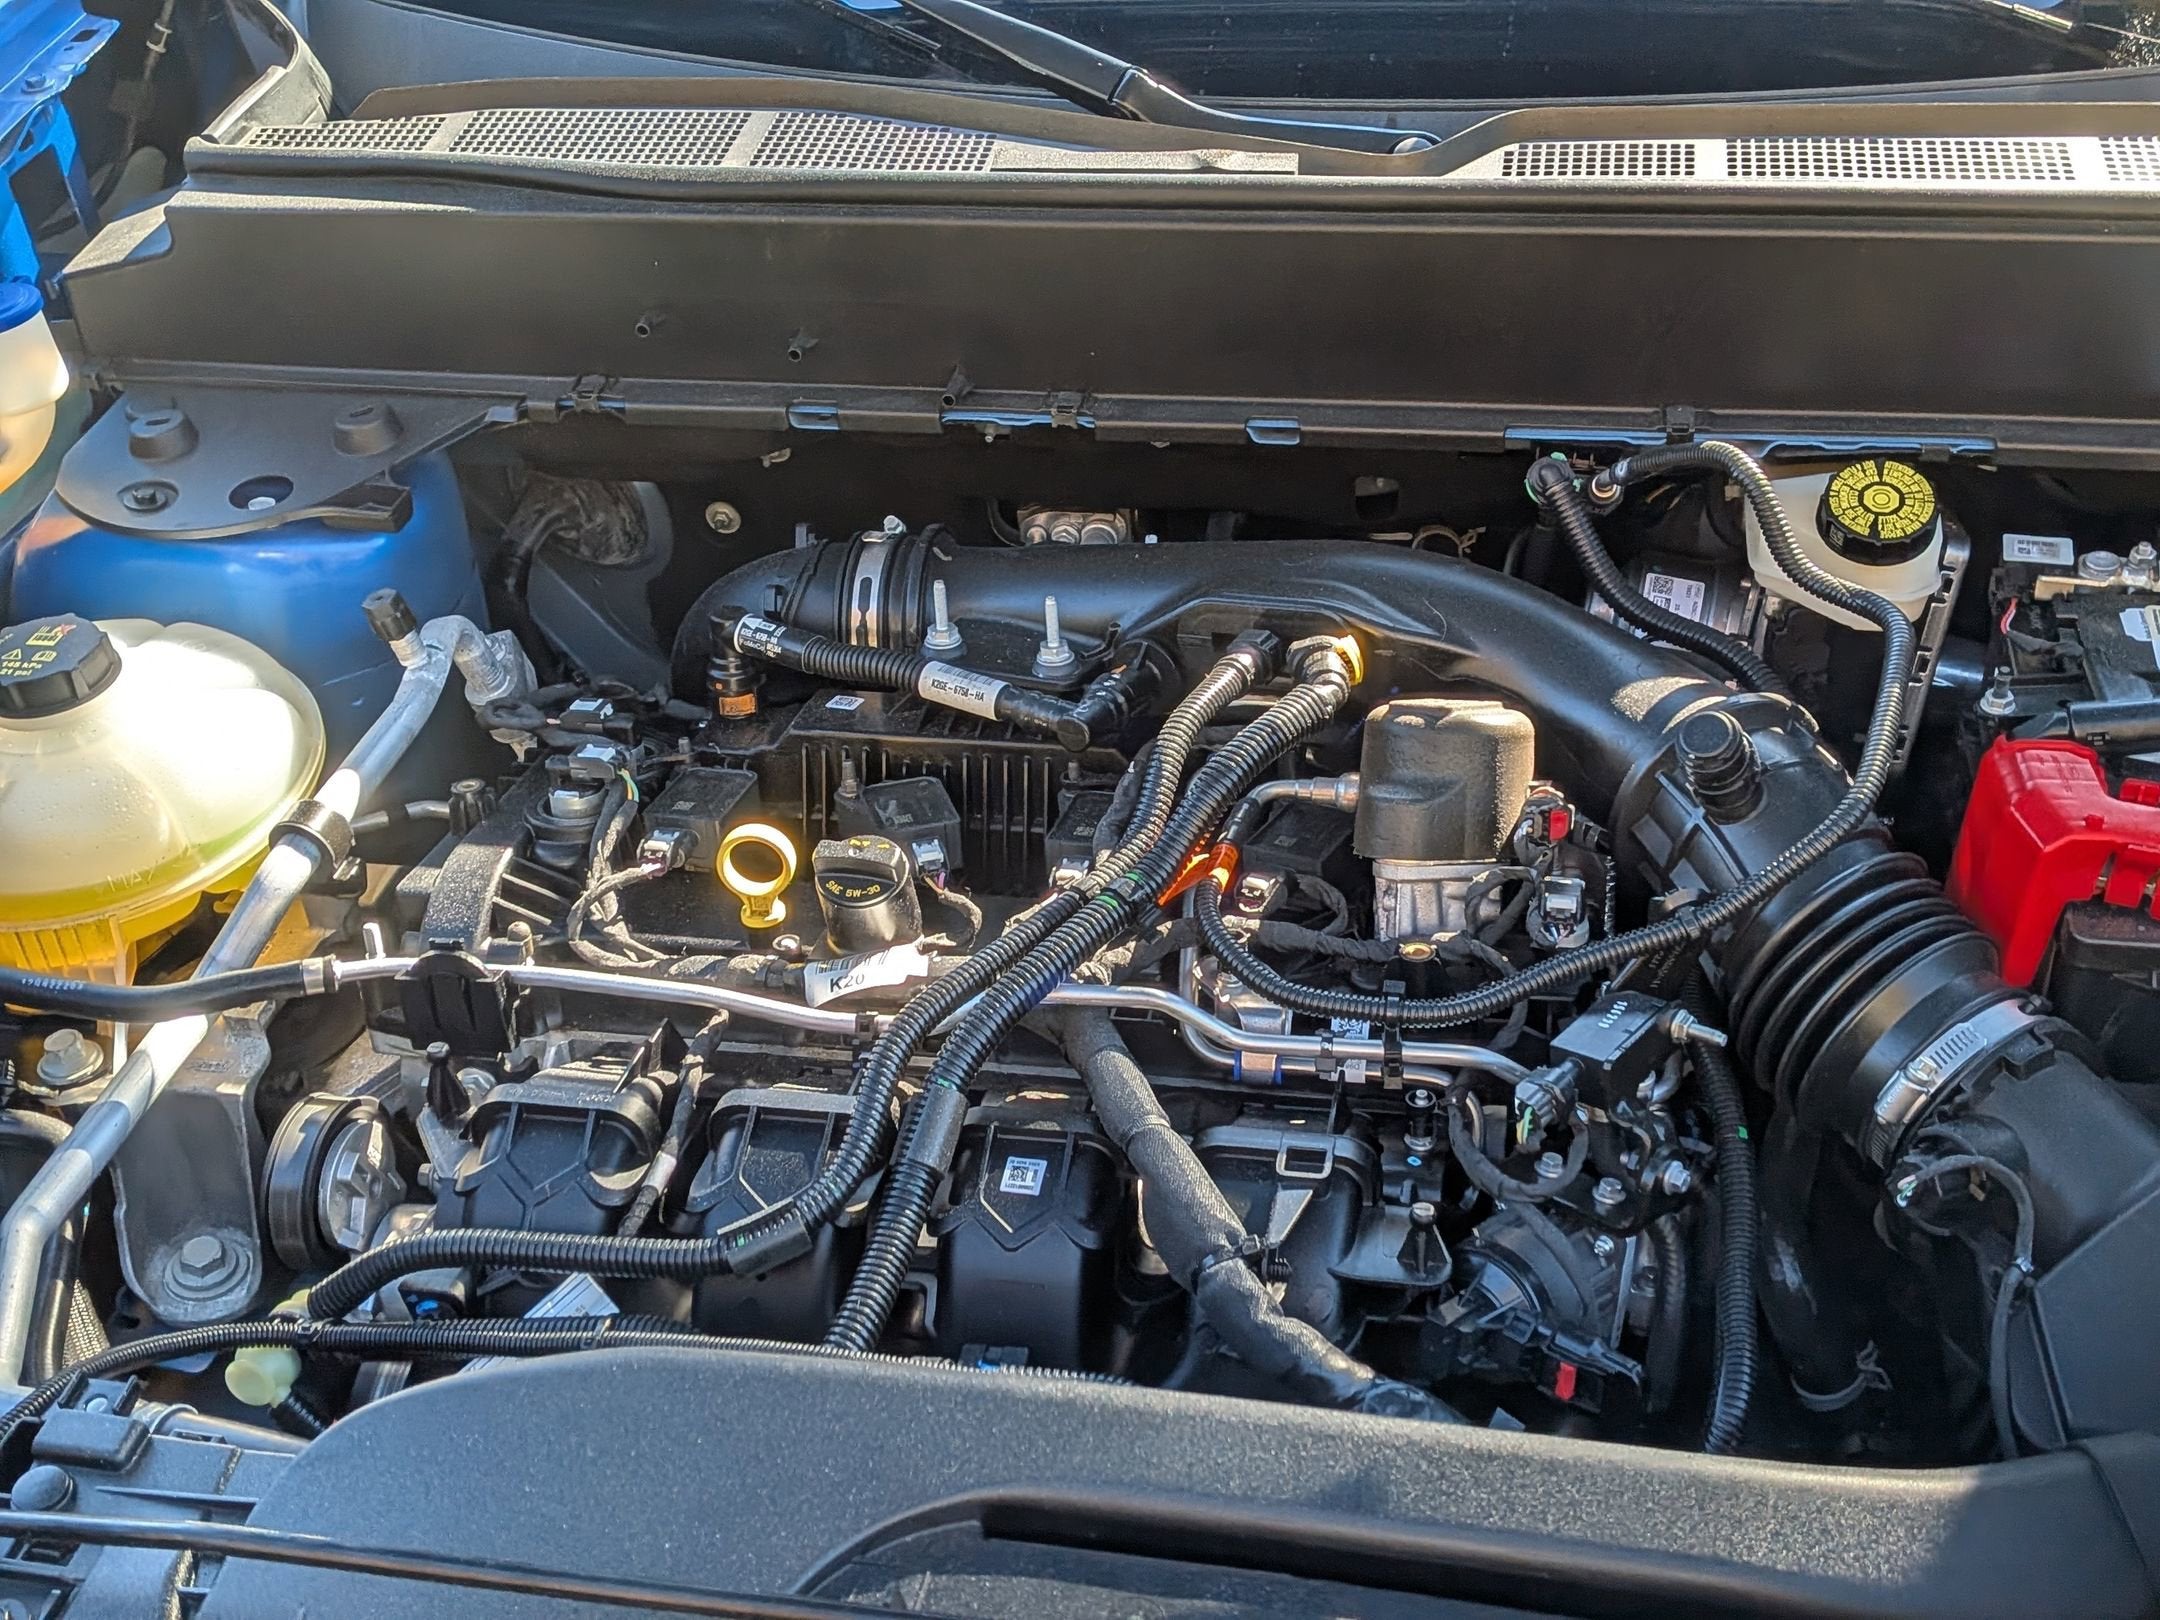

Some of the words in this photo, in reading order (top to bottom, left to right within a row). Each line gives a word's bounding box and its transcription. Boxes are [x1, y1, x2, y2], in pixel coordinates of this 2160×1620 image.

[22, 661, 43, 669] kPa
[931, 678, 985, 702] K2GE-6758-HA
[825, 880, 844, 895] SAE
[845, 884, 881, 897] 5W-30
